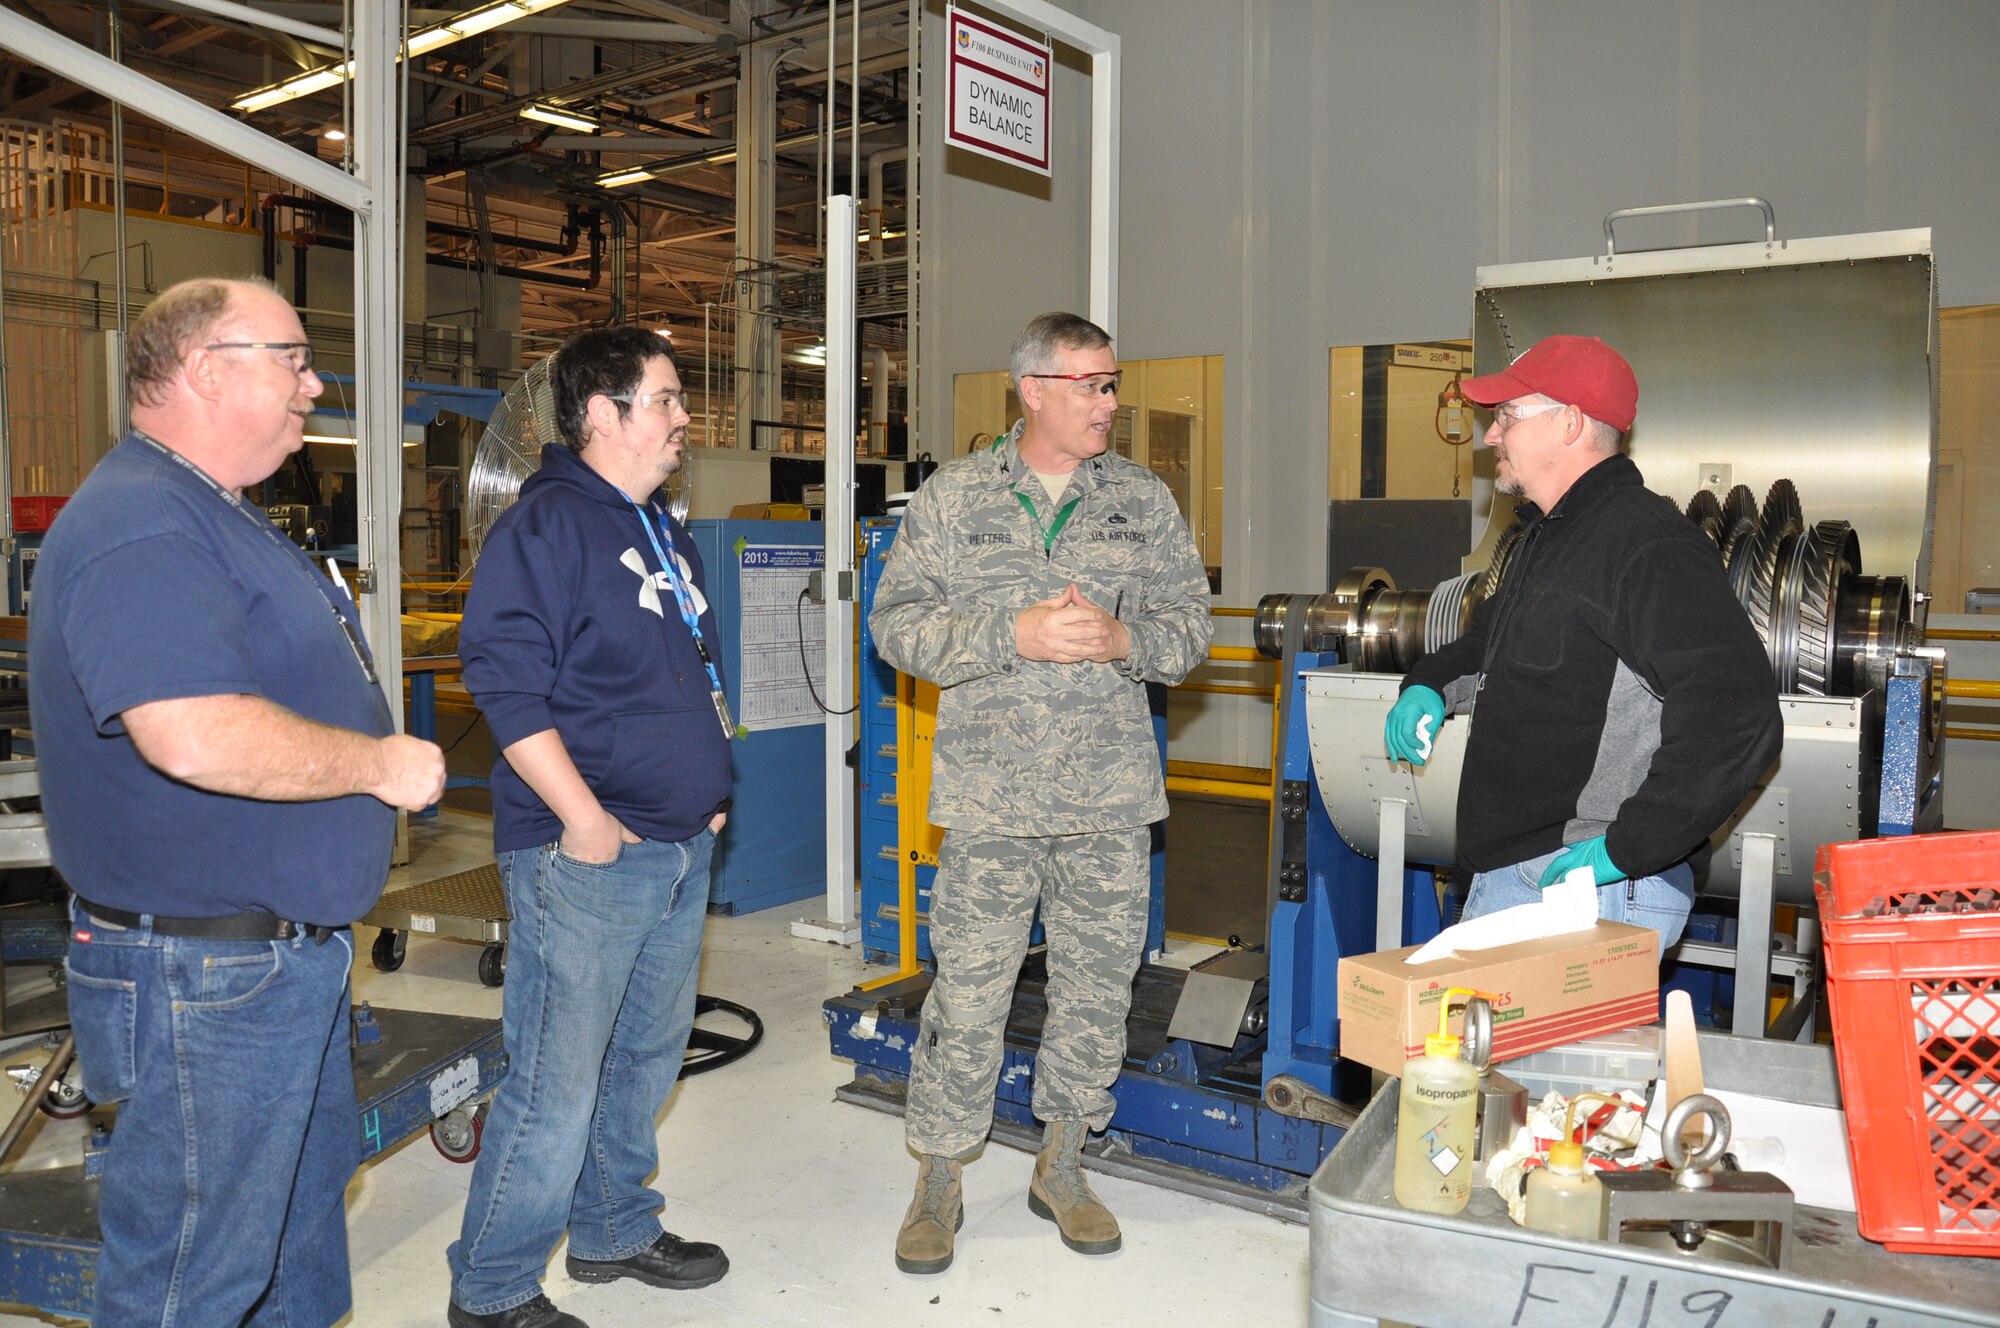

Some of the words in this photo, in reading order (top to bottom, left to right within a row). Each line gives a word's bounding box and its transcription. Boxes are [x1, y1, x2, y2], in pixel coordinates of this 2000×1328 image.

[971, 40, 986, 53] F100
[986, 46, 1017, 66] BUSINESS
[1017, 60, 1033, 73] UNIT
[970, 80, 1033, 119] DYNAMIC
[969, 106, 1033, 144] BALANCE
[1430, 352, 1443, 362] 250
[872, 531, 882, 548] F
[969, 533, 1012, 545] PETTERS
[1092, 531, 1105, 541] U.S.
[1109, 532, 1123, 541] AIR
[1124, 532, 1147, 543] FORCE
[744, 552, 768, 564] 2013
[364, 1106, 381, 1152] 4
